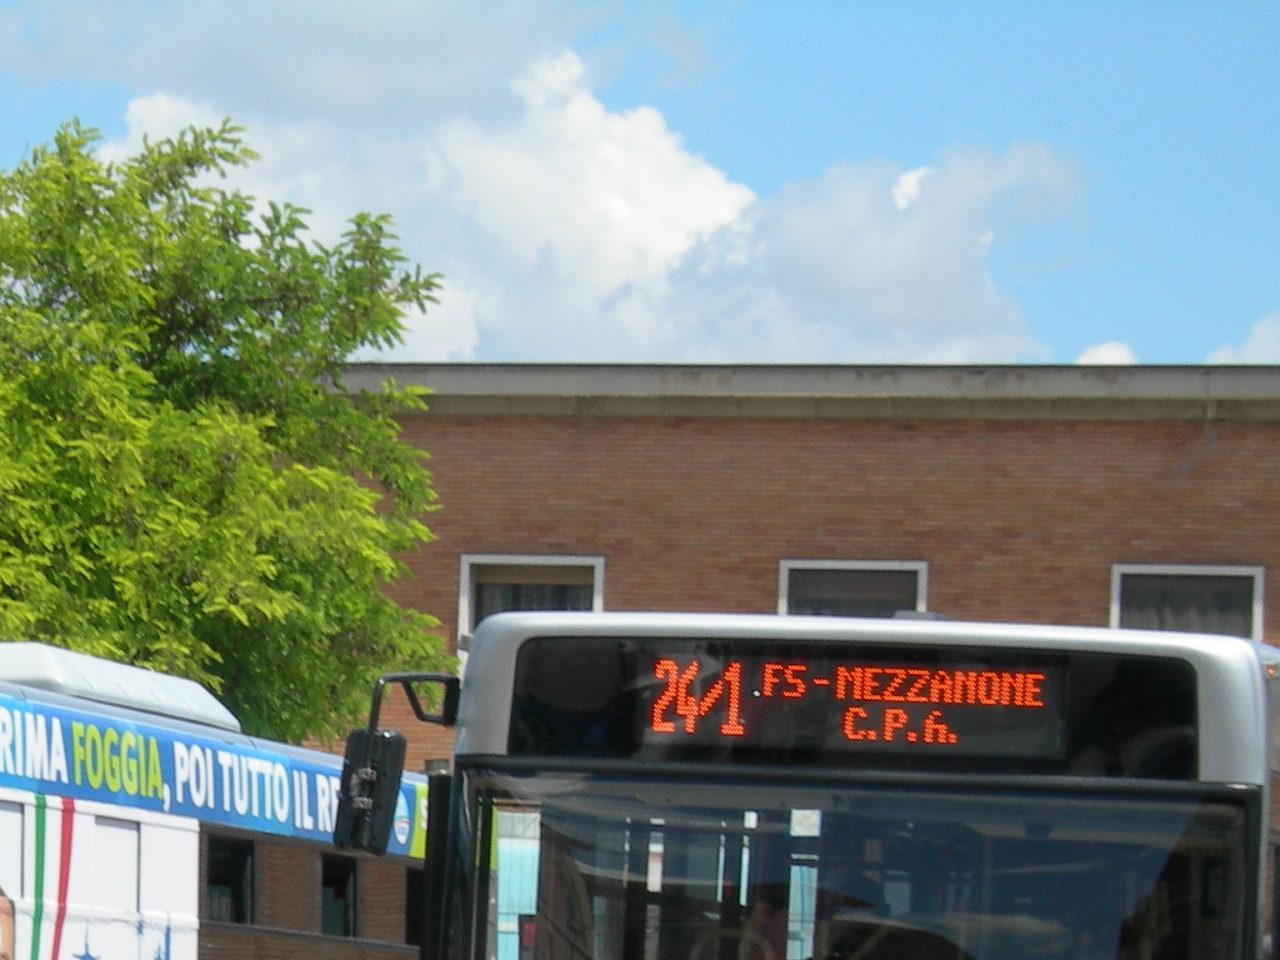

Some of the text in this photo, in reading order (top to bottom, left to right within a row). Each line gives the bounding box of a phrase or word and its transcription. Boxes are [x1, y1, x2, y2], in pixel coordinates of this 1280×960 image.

[72, 721, 171, 813] FOGGIA,
[173, 741, 215, 810] POI
[217, 750, 290, 824] TUTTO
[292, 769, 314, 830] IL
